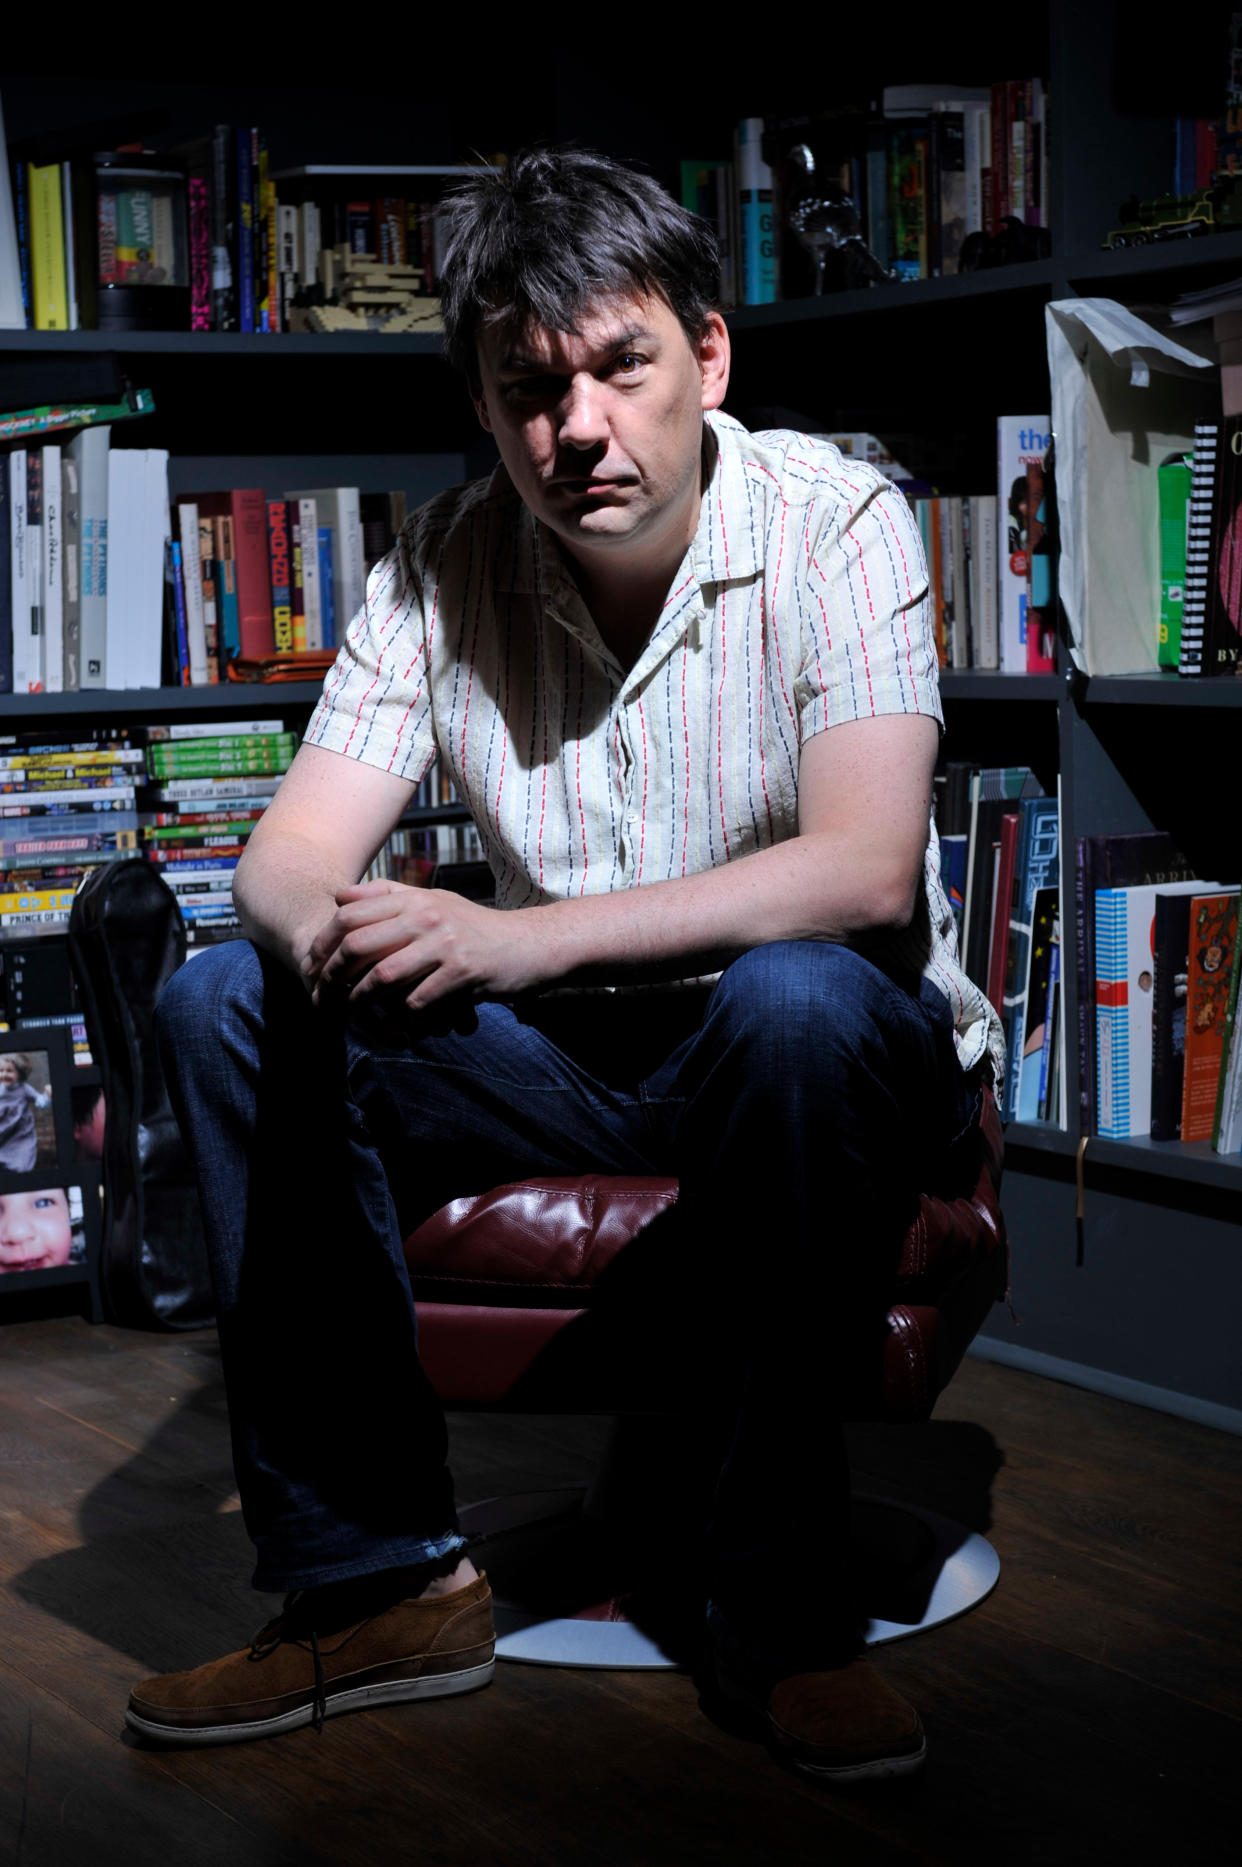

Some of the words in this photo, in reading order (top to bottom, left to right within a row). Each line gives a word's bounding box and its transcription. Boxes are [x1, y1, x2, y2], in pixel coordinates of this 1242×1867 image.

[1018, 429, 1051, 450] the
[1217, 649, 1239, 661] BY
[1075, 869, 1085, 899] THE
[10, 913, 41, 924] PRINCE
[44, 912, 54, 921] OF
[1075, 907, 1086, 973] ARRIVAL
